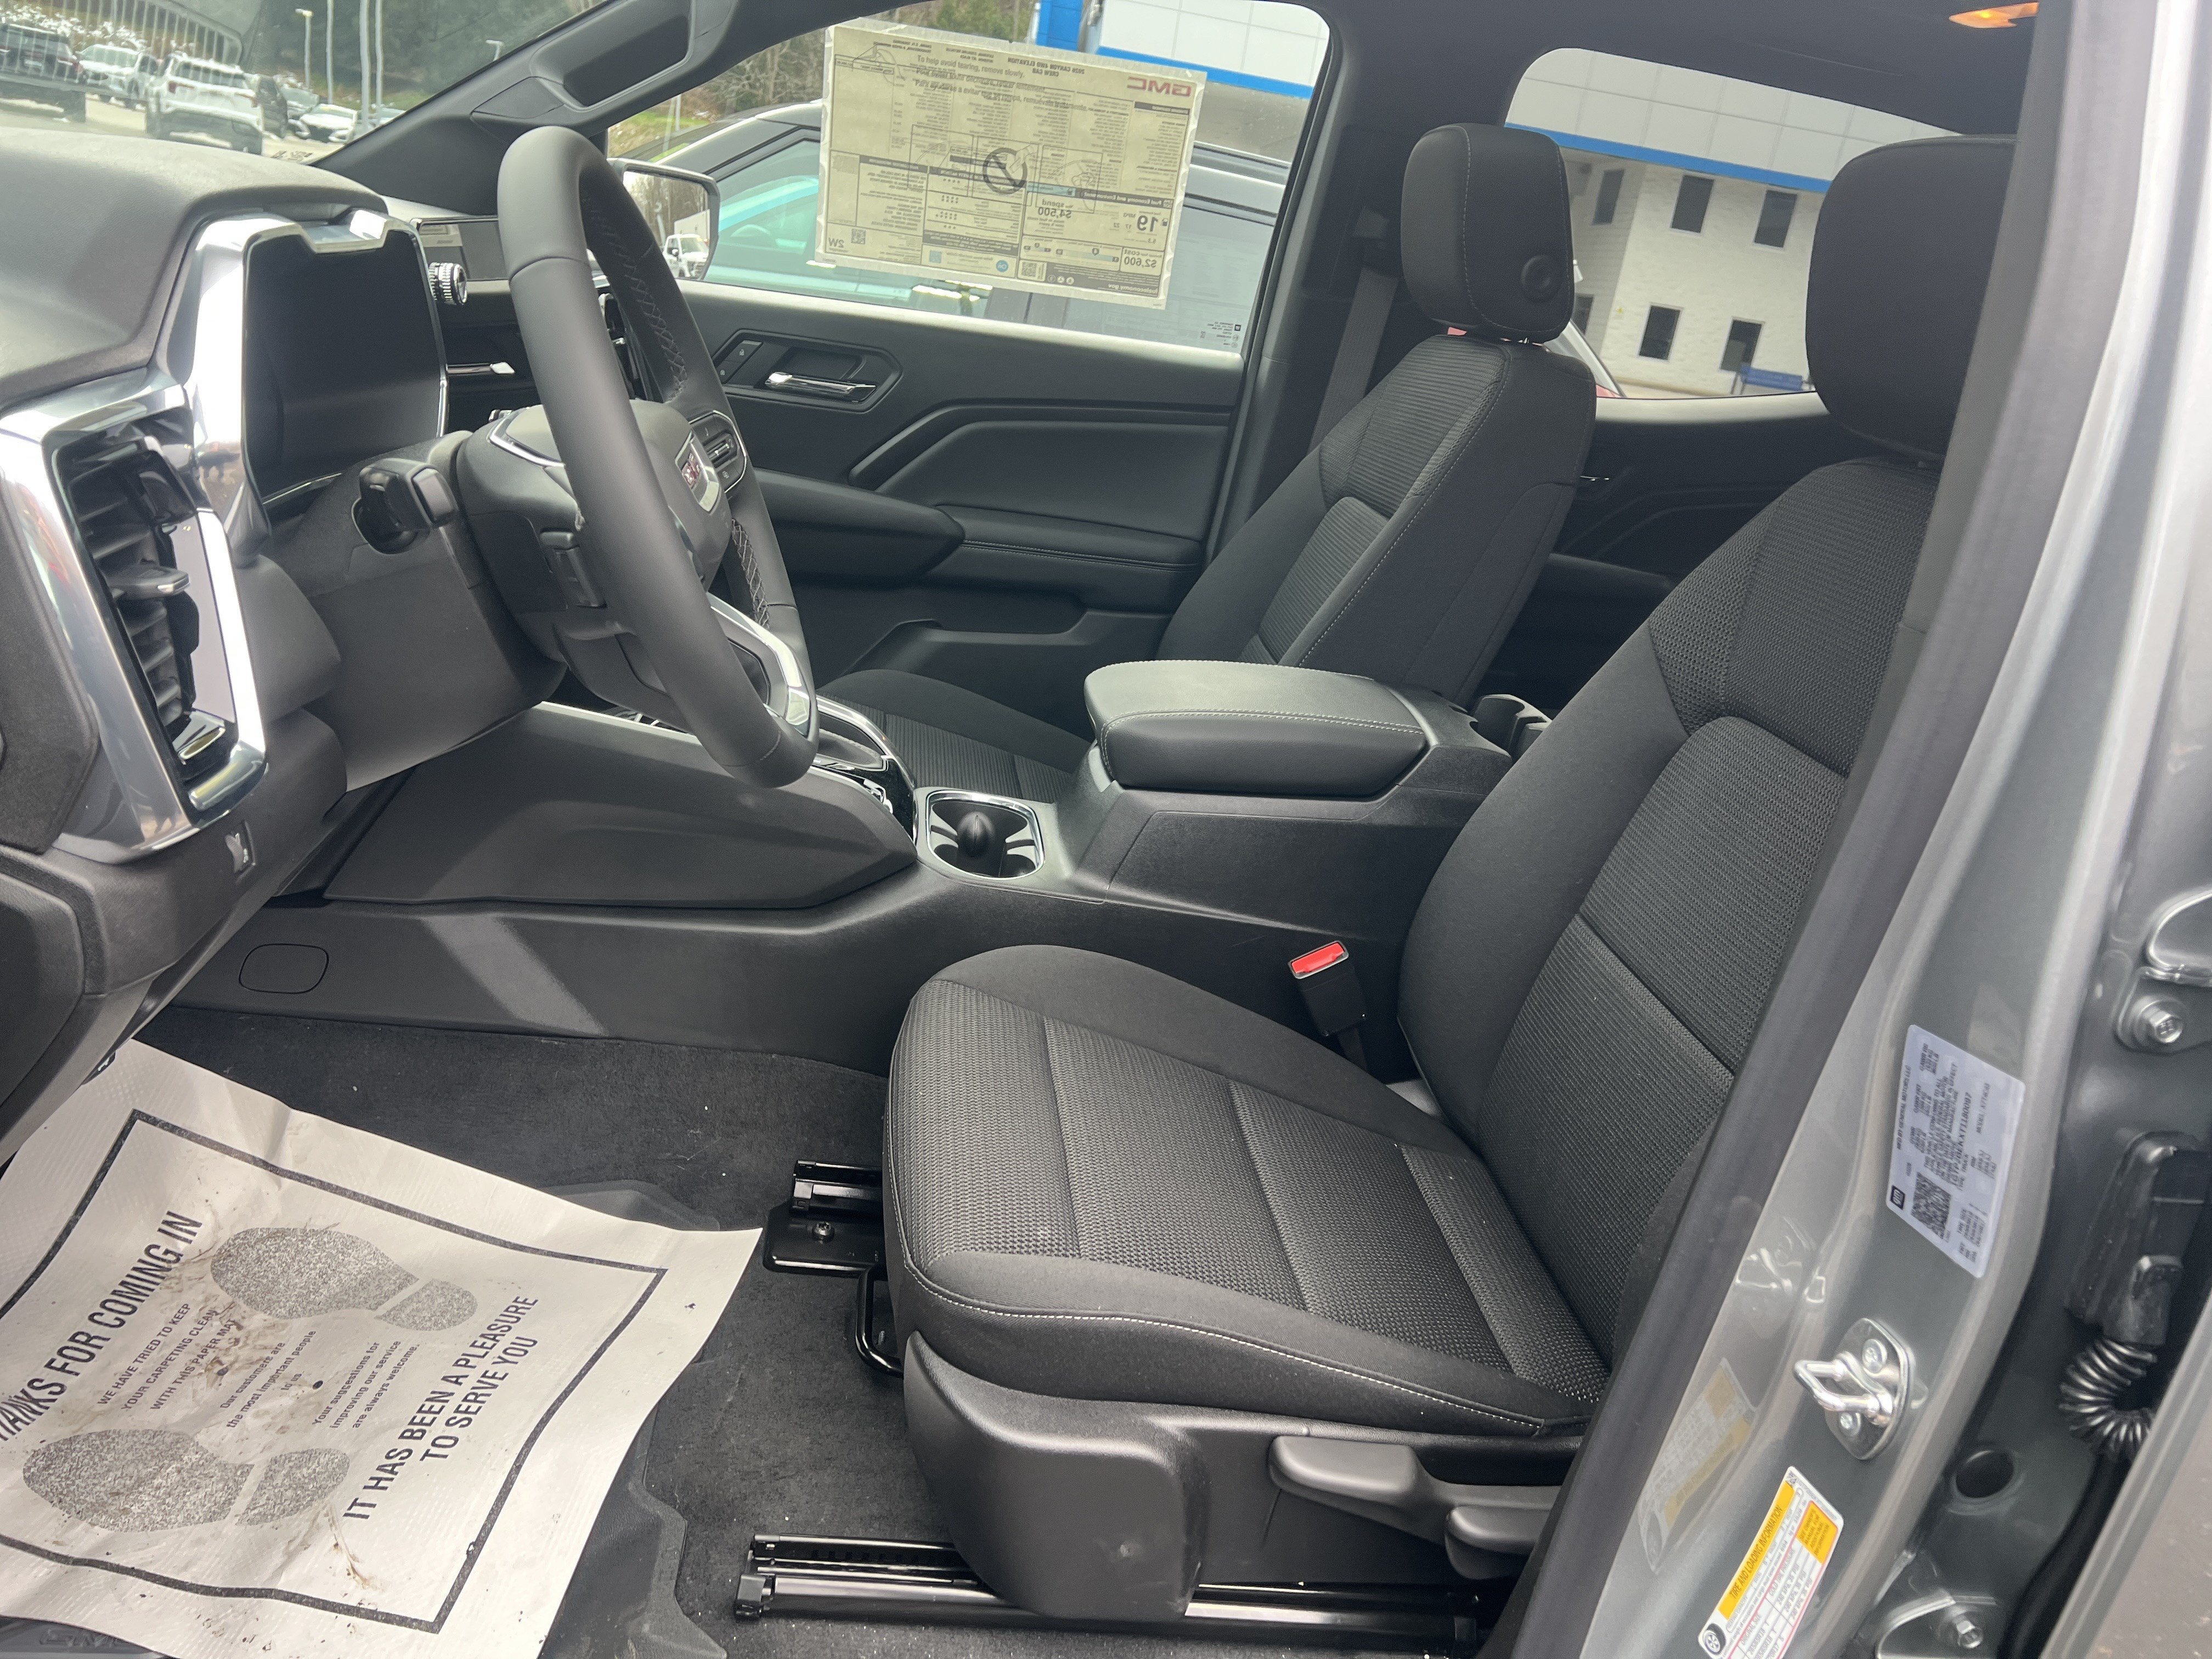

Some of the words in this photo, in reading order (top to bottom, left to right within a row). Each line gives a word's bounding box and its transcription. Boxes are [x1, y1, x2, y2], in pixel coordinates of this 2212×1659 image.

[926, 57, 939, 66] help
[1898, 1101, 1906, 1130] GENERAL
[1901, 1076, 1910, 1103] MOTORS
[44, 1331, 111, 1376] FOR
[88, 1244, 183, 1329] COMING
[157, 1210, 202, 1244] IN
[452, 1295, 539, 1369] PLEASURE
[97, 1390, 116, 1405] WE
[112, 1365, 139, 1390] HAVE
[133, 1339, 161, 1364] TRIED
[156, 1326, 173, 1338] TO
[168, 1303, 191, 1325] KEEP
[121, 1385, 150, 1410] YOUR
[145, 1338, 193, 1384] CARPETING
[188, 1310, 218, 1337] CLEAN
[150, 1386, 177, 1410] WITH
[172, 1365, 195, 1385] THIS
[191, 1338, 221, 1365] PAPER
[216, 1318, 237, 1337] MAT
[219, 1395, 238, 1409] Our
[235, 1356, 274, 1394] customers
[270, 1342, 285, 1355] are
[226, 1414, 244, 1428] the
[240, 1393, 262, 1413] most
[256, 1357, 295, 1393] important
[291, 1330, 317, 1357] people
[312, 1406, 333, 1425] Your
[365, 1342, 380, 1355] for
[329, 1385, 369, 1429] improving
[364, 1370, 379, 1385] our
[375, 1340, 402, 1369] service
[352, 1414, 367, 1429] are
[364, 1383, 390, 1413] always
[386, 1344, 420, 1383] welcome.
[441, 1373, 470, 1386] A
[398, 1390, 455, 1441] BEEN
[419, 1435, 460, 1462] TO
[444, 1369, 509, 1429] SERVE
[491, 1335, 539, 1365] YOU
[342, 1497, 377, 1520] IT
[363, 1448, 413, 1491] HAS
[1729, 1581, 1742, 1600] TIRE
[1736, 1568, 1750, 1587] AND
[1743, 1542, 1763, 1573] LOADING
[1757, 1504, 1784, 1547] INFORMATION
[1780, 1547, 1795, 1573] PRESSURE
